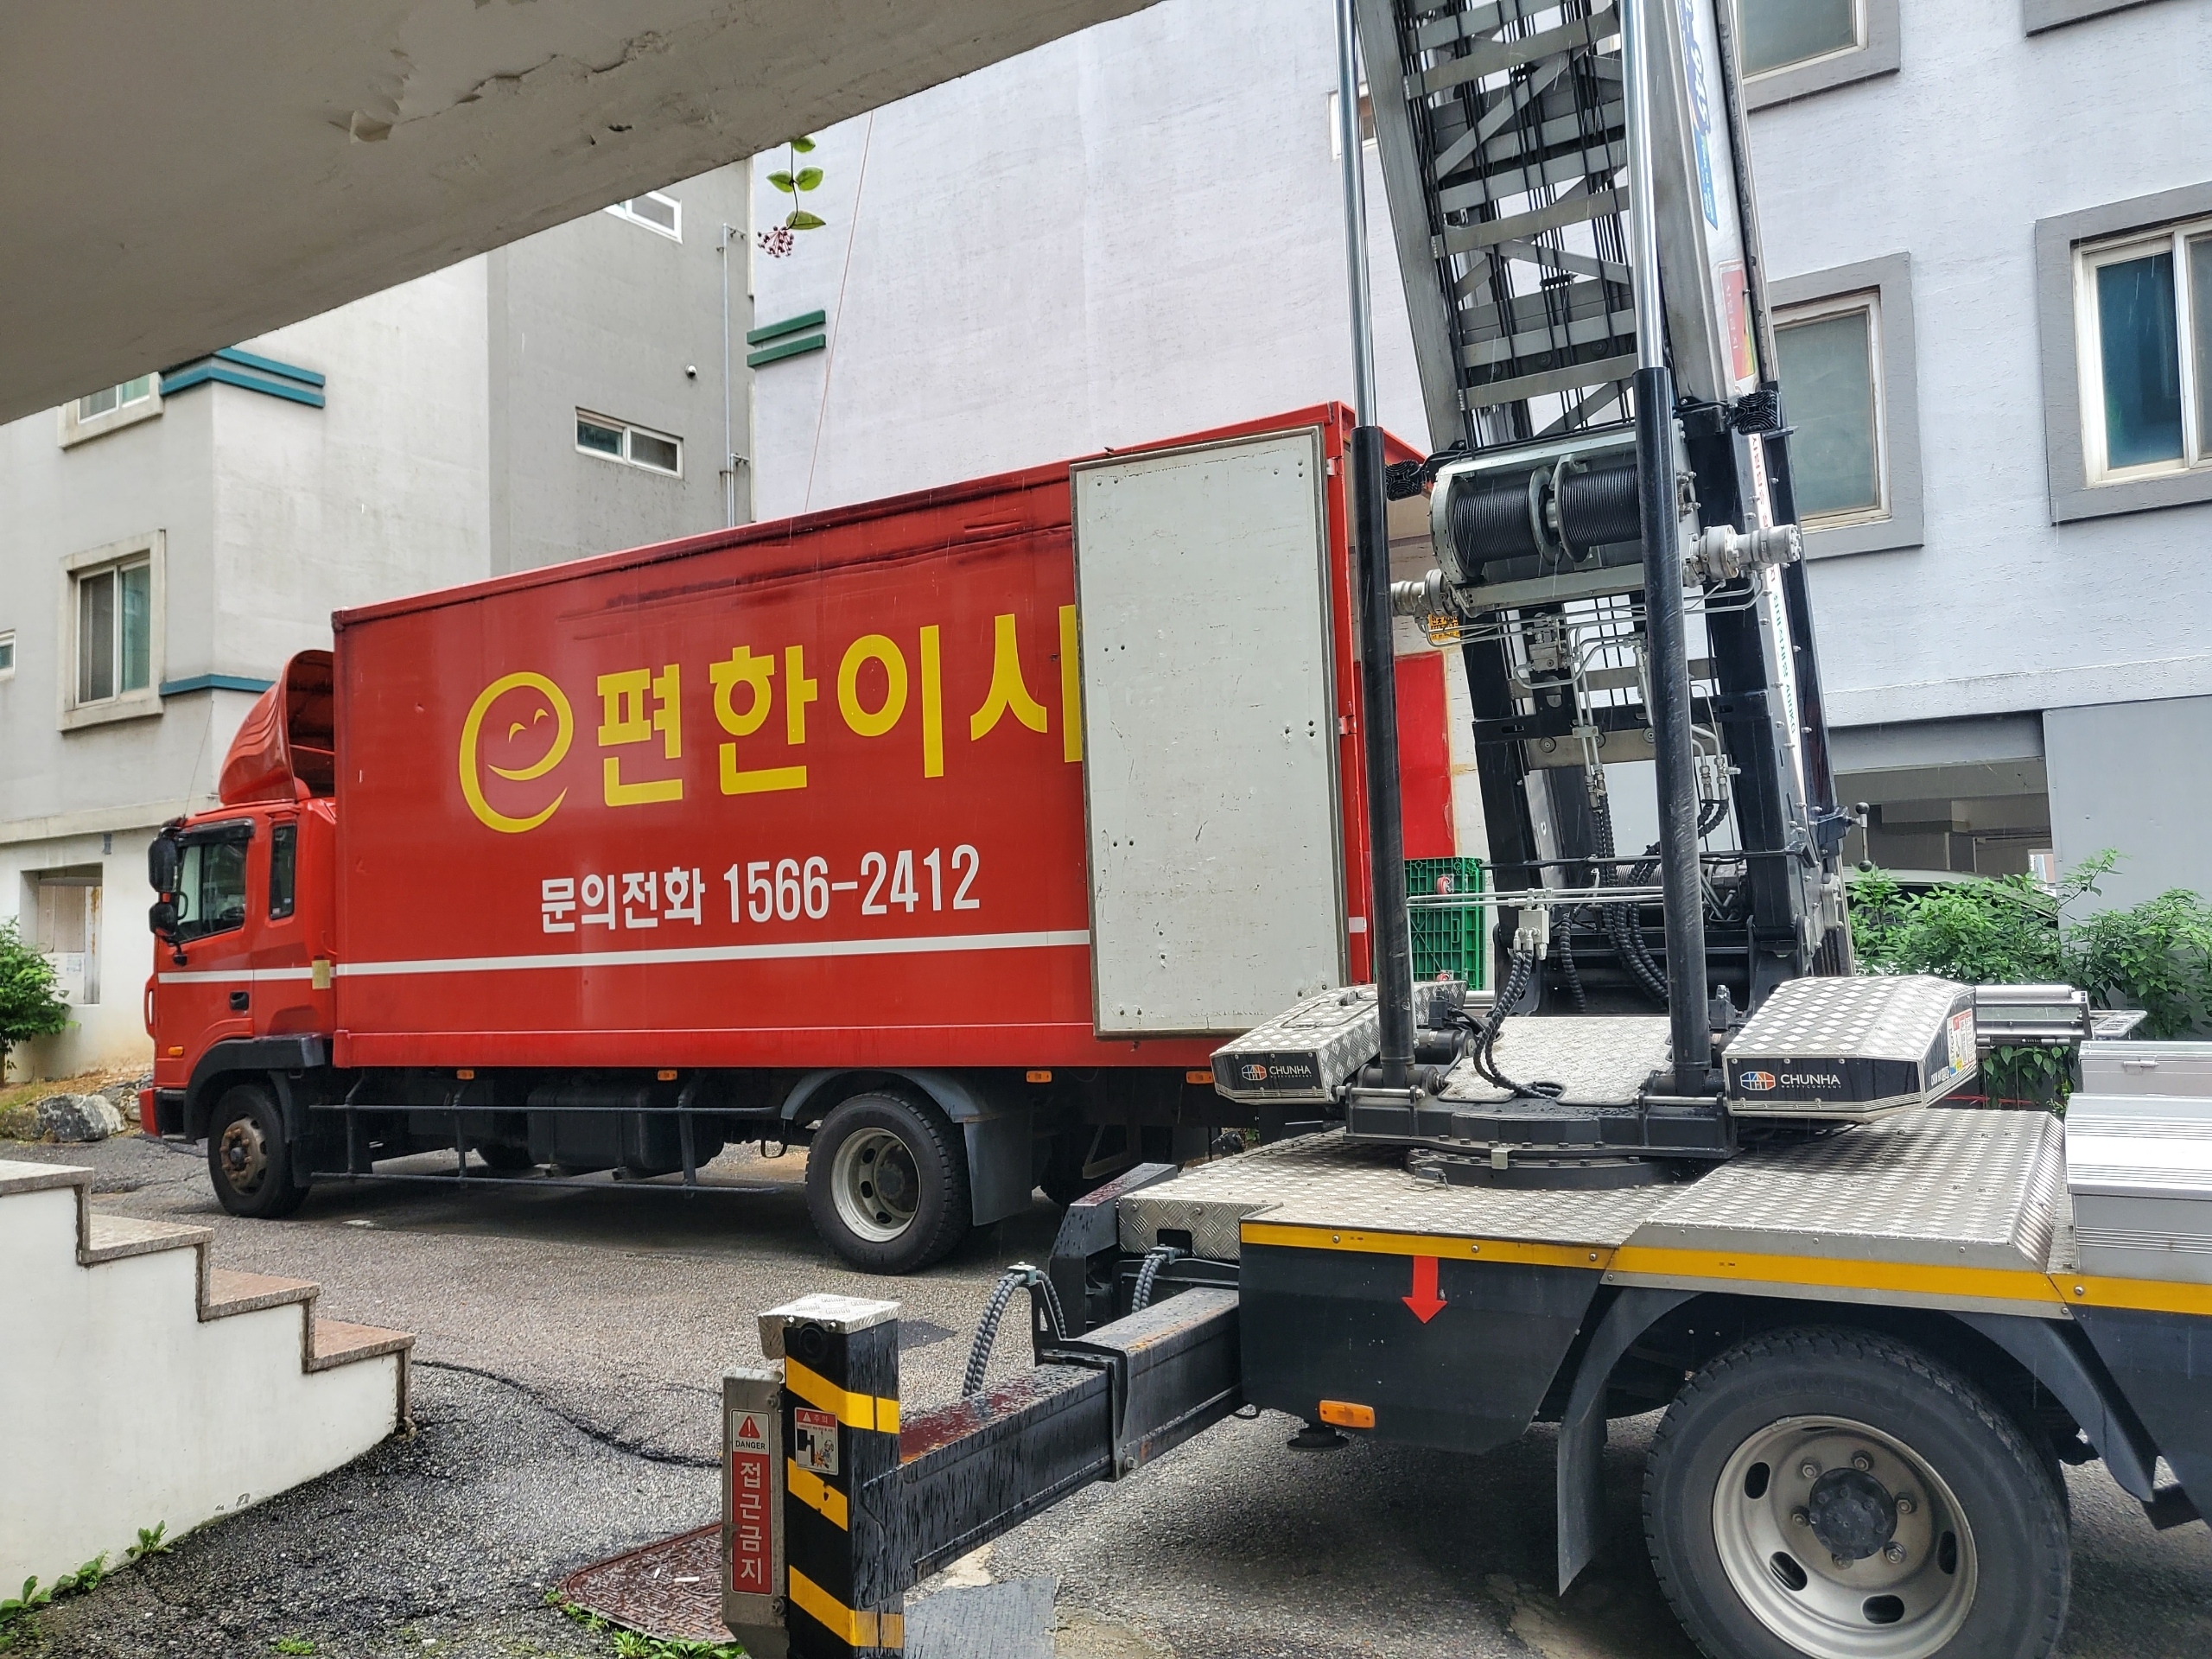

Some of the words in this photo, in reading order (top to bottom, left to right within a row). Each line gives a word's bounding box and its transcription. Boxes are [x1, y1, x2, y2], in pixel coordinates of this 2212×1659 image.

[1784, 683, 1796, 734] 400KG
[541, 866, 706, 933] 문의전화
[723, 843, 982, 924] 1566-2412
[1268, 1065, 1312, 1075] CHUNHA
[1780, 1073, 1841, 1085] CHUNHA
[813, 1414, 829, 1425] 주의
[735, 1440, 766, 1451] DANGER
[739, 1461, 762, 1586] 접근금지
